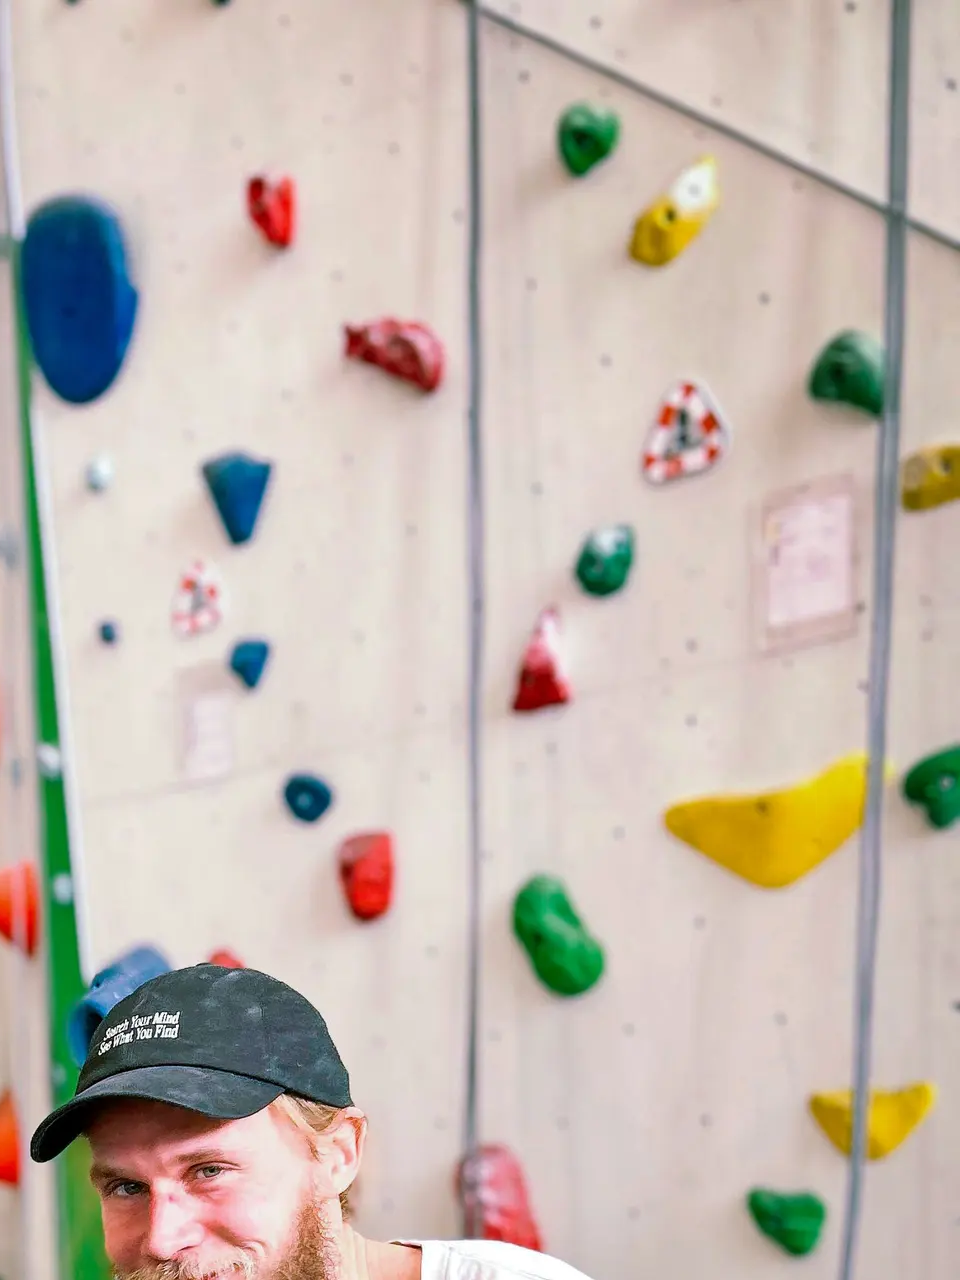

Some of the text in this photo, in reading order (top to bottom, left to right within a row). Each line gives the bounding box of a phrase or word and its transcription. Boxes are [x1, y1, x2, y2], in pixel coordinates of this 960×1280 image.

[97, 1024, 179, 1056] See What You Find
[103, 1011, 180, 1040] Search Your Mind
